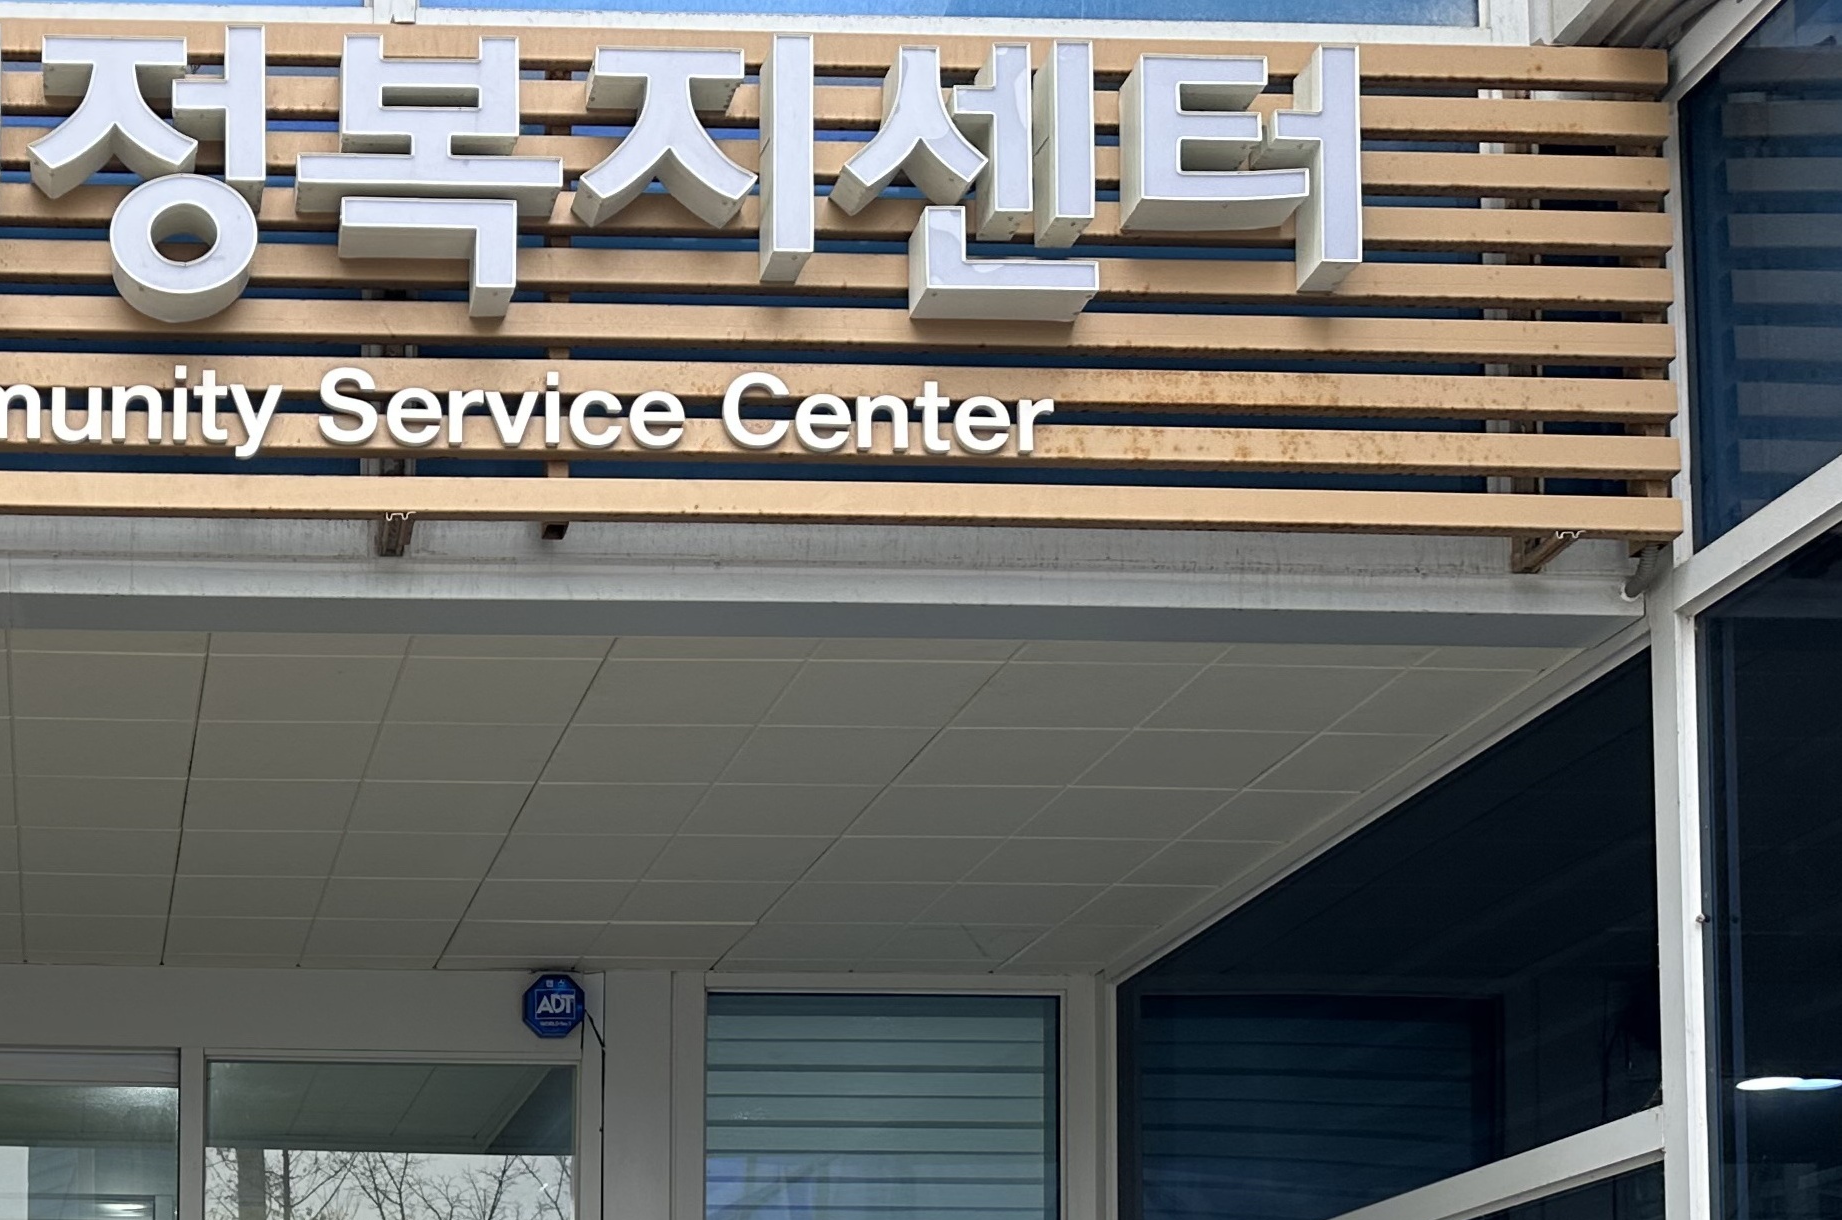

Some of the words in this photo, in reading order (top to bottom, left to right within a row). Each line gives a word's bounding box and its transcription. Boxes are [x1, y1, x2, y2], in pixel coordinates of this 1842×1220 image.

[317, 366, 685, 450] Service
[721, 371, 1053, 454] Center
[536, 994, 575, 1014] ADT
